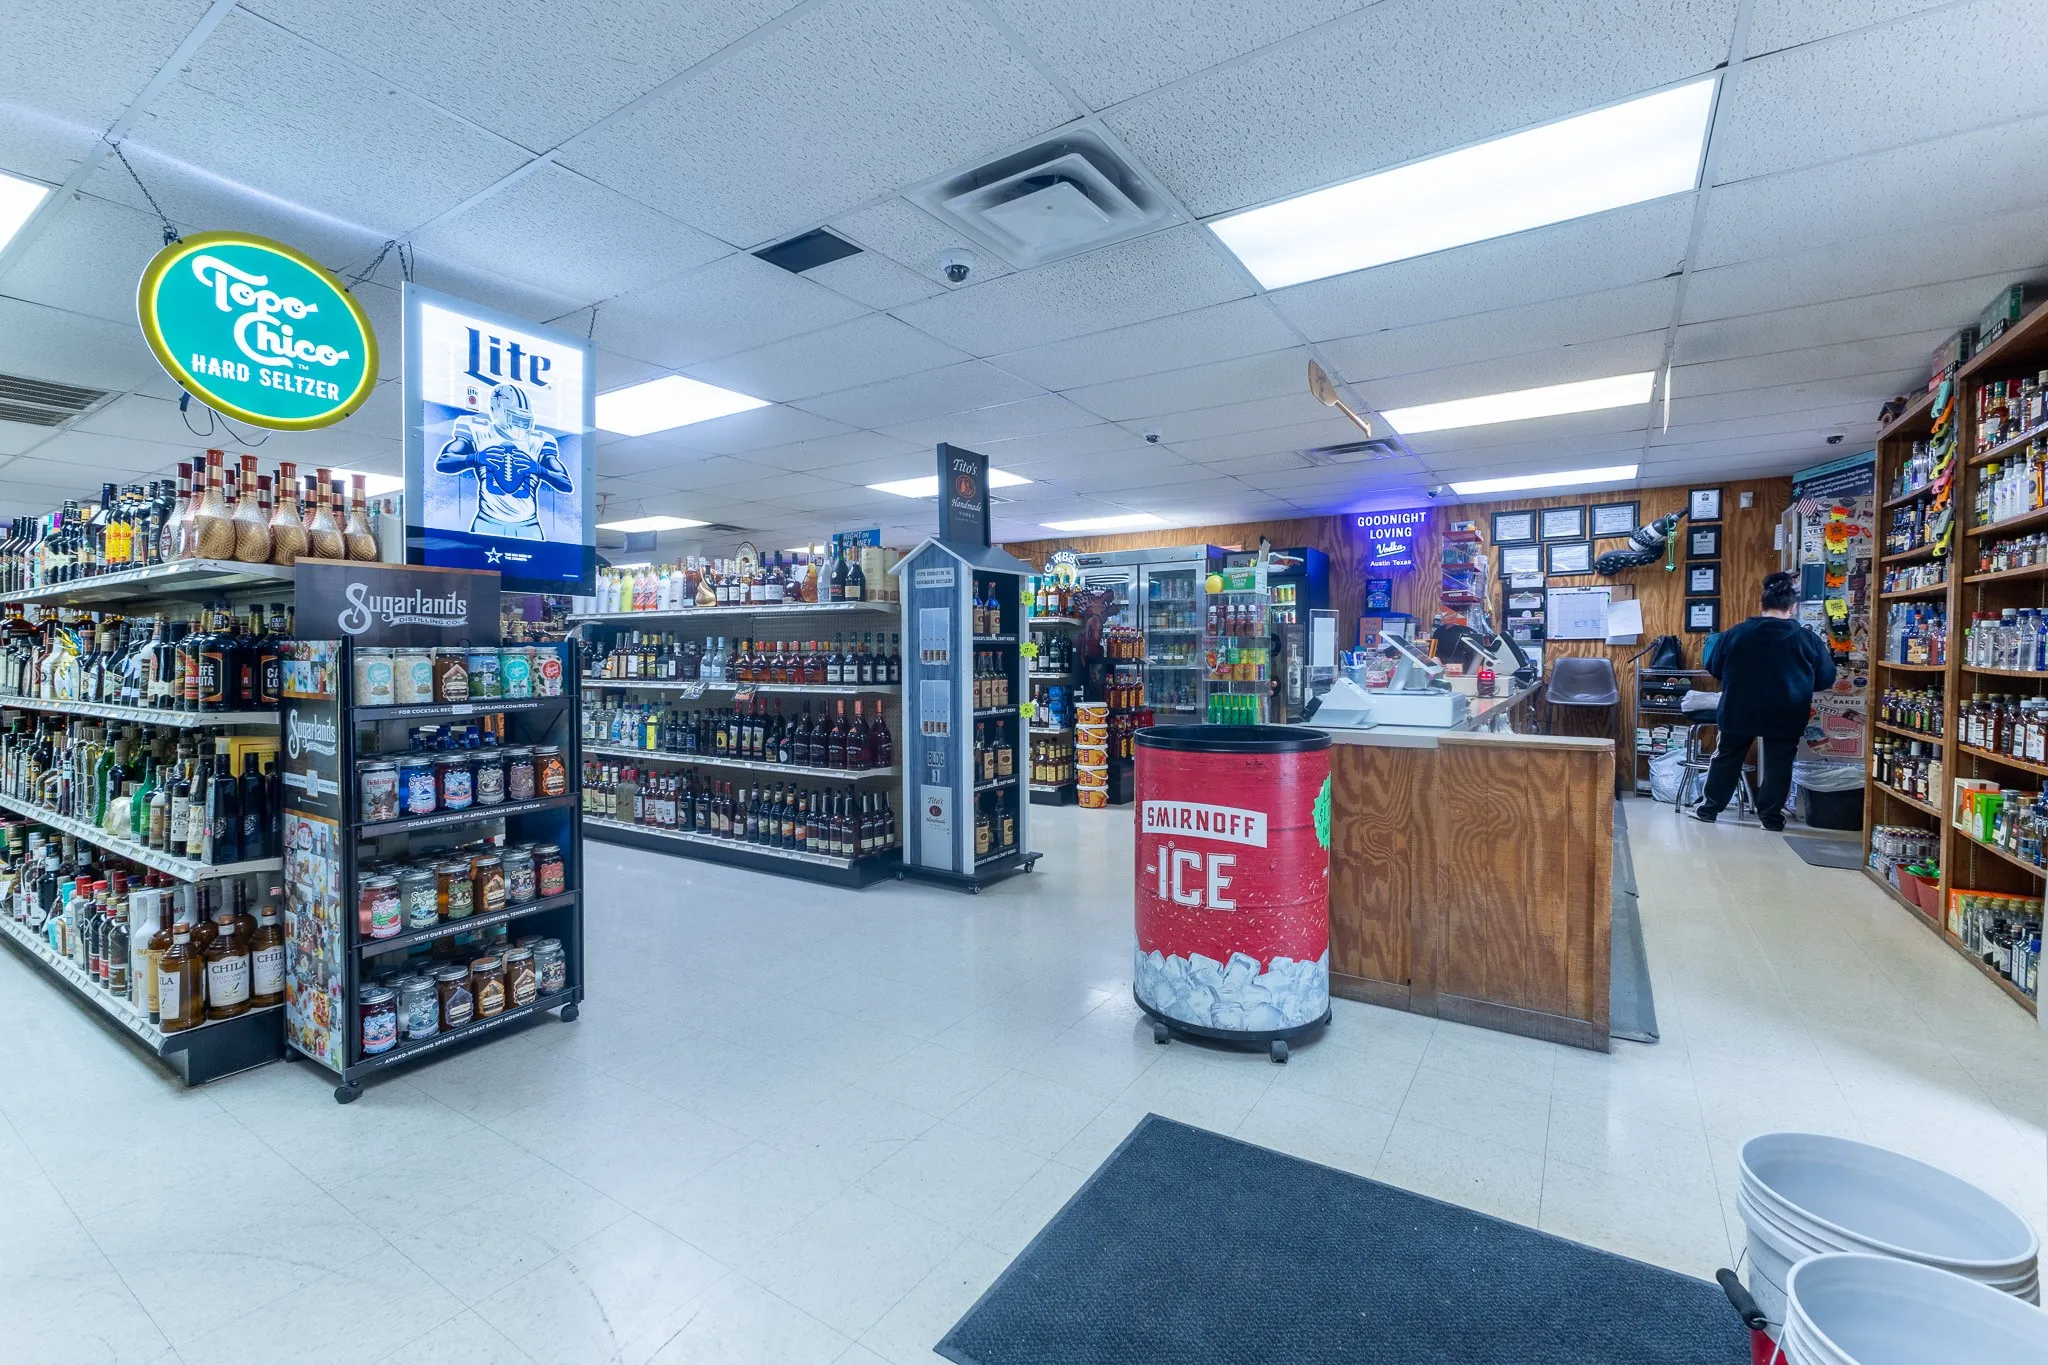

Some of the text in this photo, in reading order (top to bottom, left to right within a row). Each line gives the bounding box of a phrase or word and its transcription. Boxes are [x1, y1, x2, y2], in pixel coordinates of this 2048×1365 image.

[191, 254, 319, 320] Topo
[233, 311, 350, 368] Chico
[463, 326, 551, 387] Lite
[191, 353, 340, 401] HARD SELTZER
[953, 458, 978, 476] Tito's
[951, 498, 981, 511] Handmade
[1357, 512, 1426, 527] GOODNIGHT
[1369, 527, 1412, 539] LOVING
[1376, 541, 1406, 557] Vodka
[337, 582, 467, 635] Sugarlands
[399, 615, 444, 625] DISTILLING
[1819, 705, 1837, 714] YETI
[288, 708, 336, 759] Sugarlands
[928, 752, 944, 766] BLDG
[934, 771, 938, 781] 1
[928, 797, 943, 805] Tito's
[407, 818, 445, 828] SUGARLANDS
[470, 809, 505, 818] APPALACHIAN
[1147, 806, 1255, 838] SMIRNOFF
[1158, 844, 1237, 912] ICE
[414, 934, 429, 942] VISIT
[443, 923, 473, 935] DISTILLERY
[476, 913, 510, 926] GATLINBURG,
[510, 906, 537, 916] TENNESSEE
[211, 962, 248, 974] CHILA
[384, 1008, 533, 1064] AWARD-WINNING SPIRITS GREAT SMOKY MOUNTAINS
